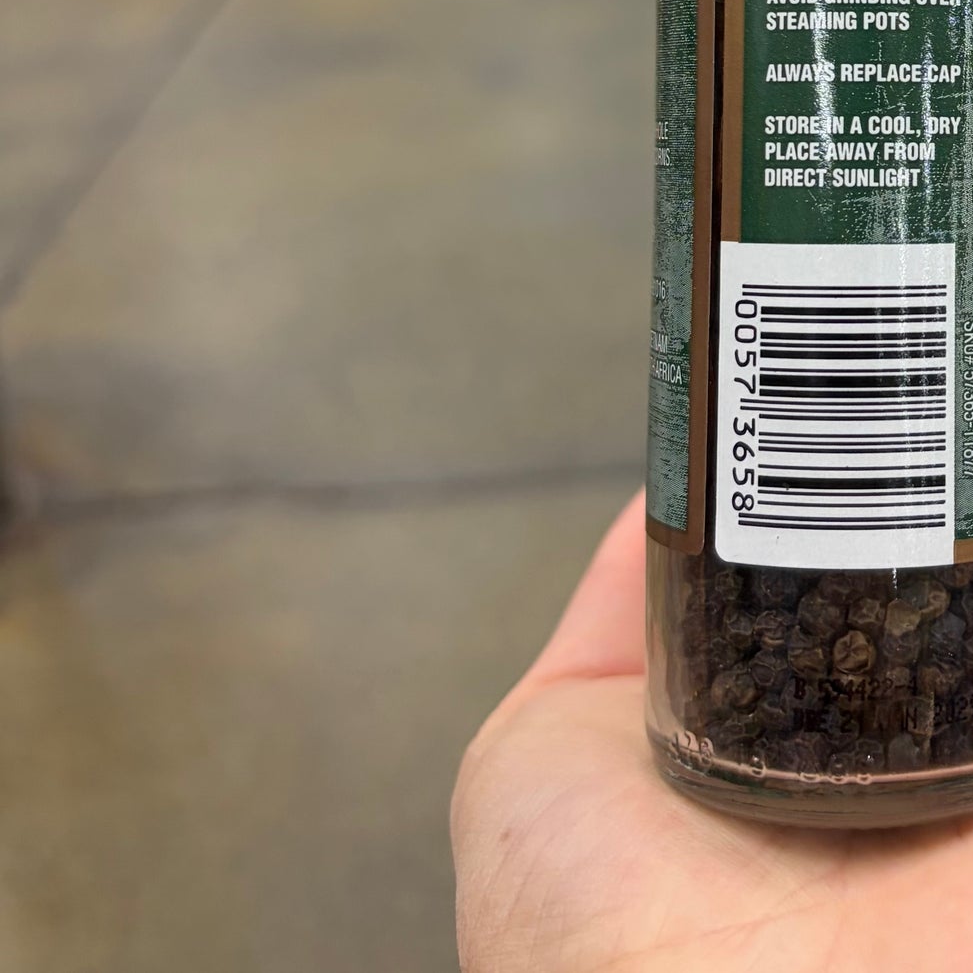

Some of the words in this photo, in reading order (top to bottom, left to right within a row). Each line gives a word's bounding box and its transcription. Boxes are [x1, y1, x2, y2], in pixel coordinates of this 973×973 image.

[766, 11, 857, 31] STEAMING
[863, 11, 910, 31] POTS
[765, 63, 836, 82] ALWAYS
[840, 63, 922, 83] REPLACE
[926, 64, 962, 83] CAP
[765, 115, 820, 135] STORE
[826, 116, 844, 135] IN
[850, 116, 863, 135] A
[868, 115, 921, 138] COOL,
[929, 116, 961, 135] DRY
[765, 142, 820, 161] PLACE
[825, 142, 878, 161] AWAY
[884, 142, 936, 161] FROM
[764, 168, 827, 187] DIRECT
[832, 168, 920, 188] SUNLIGHT
